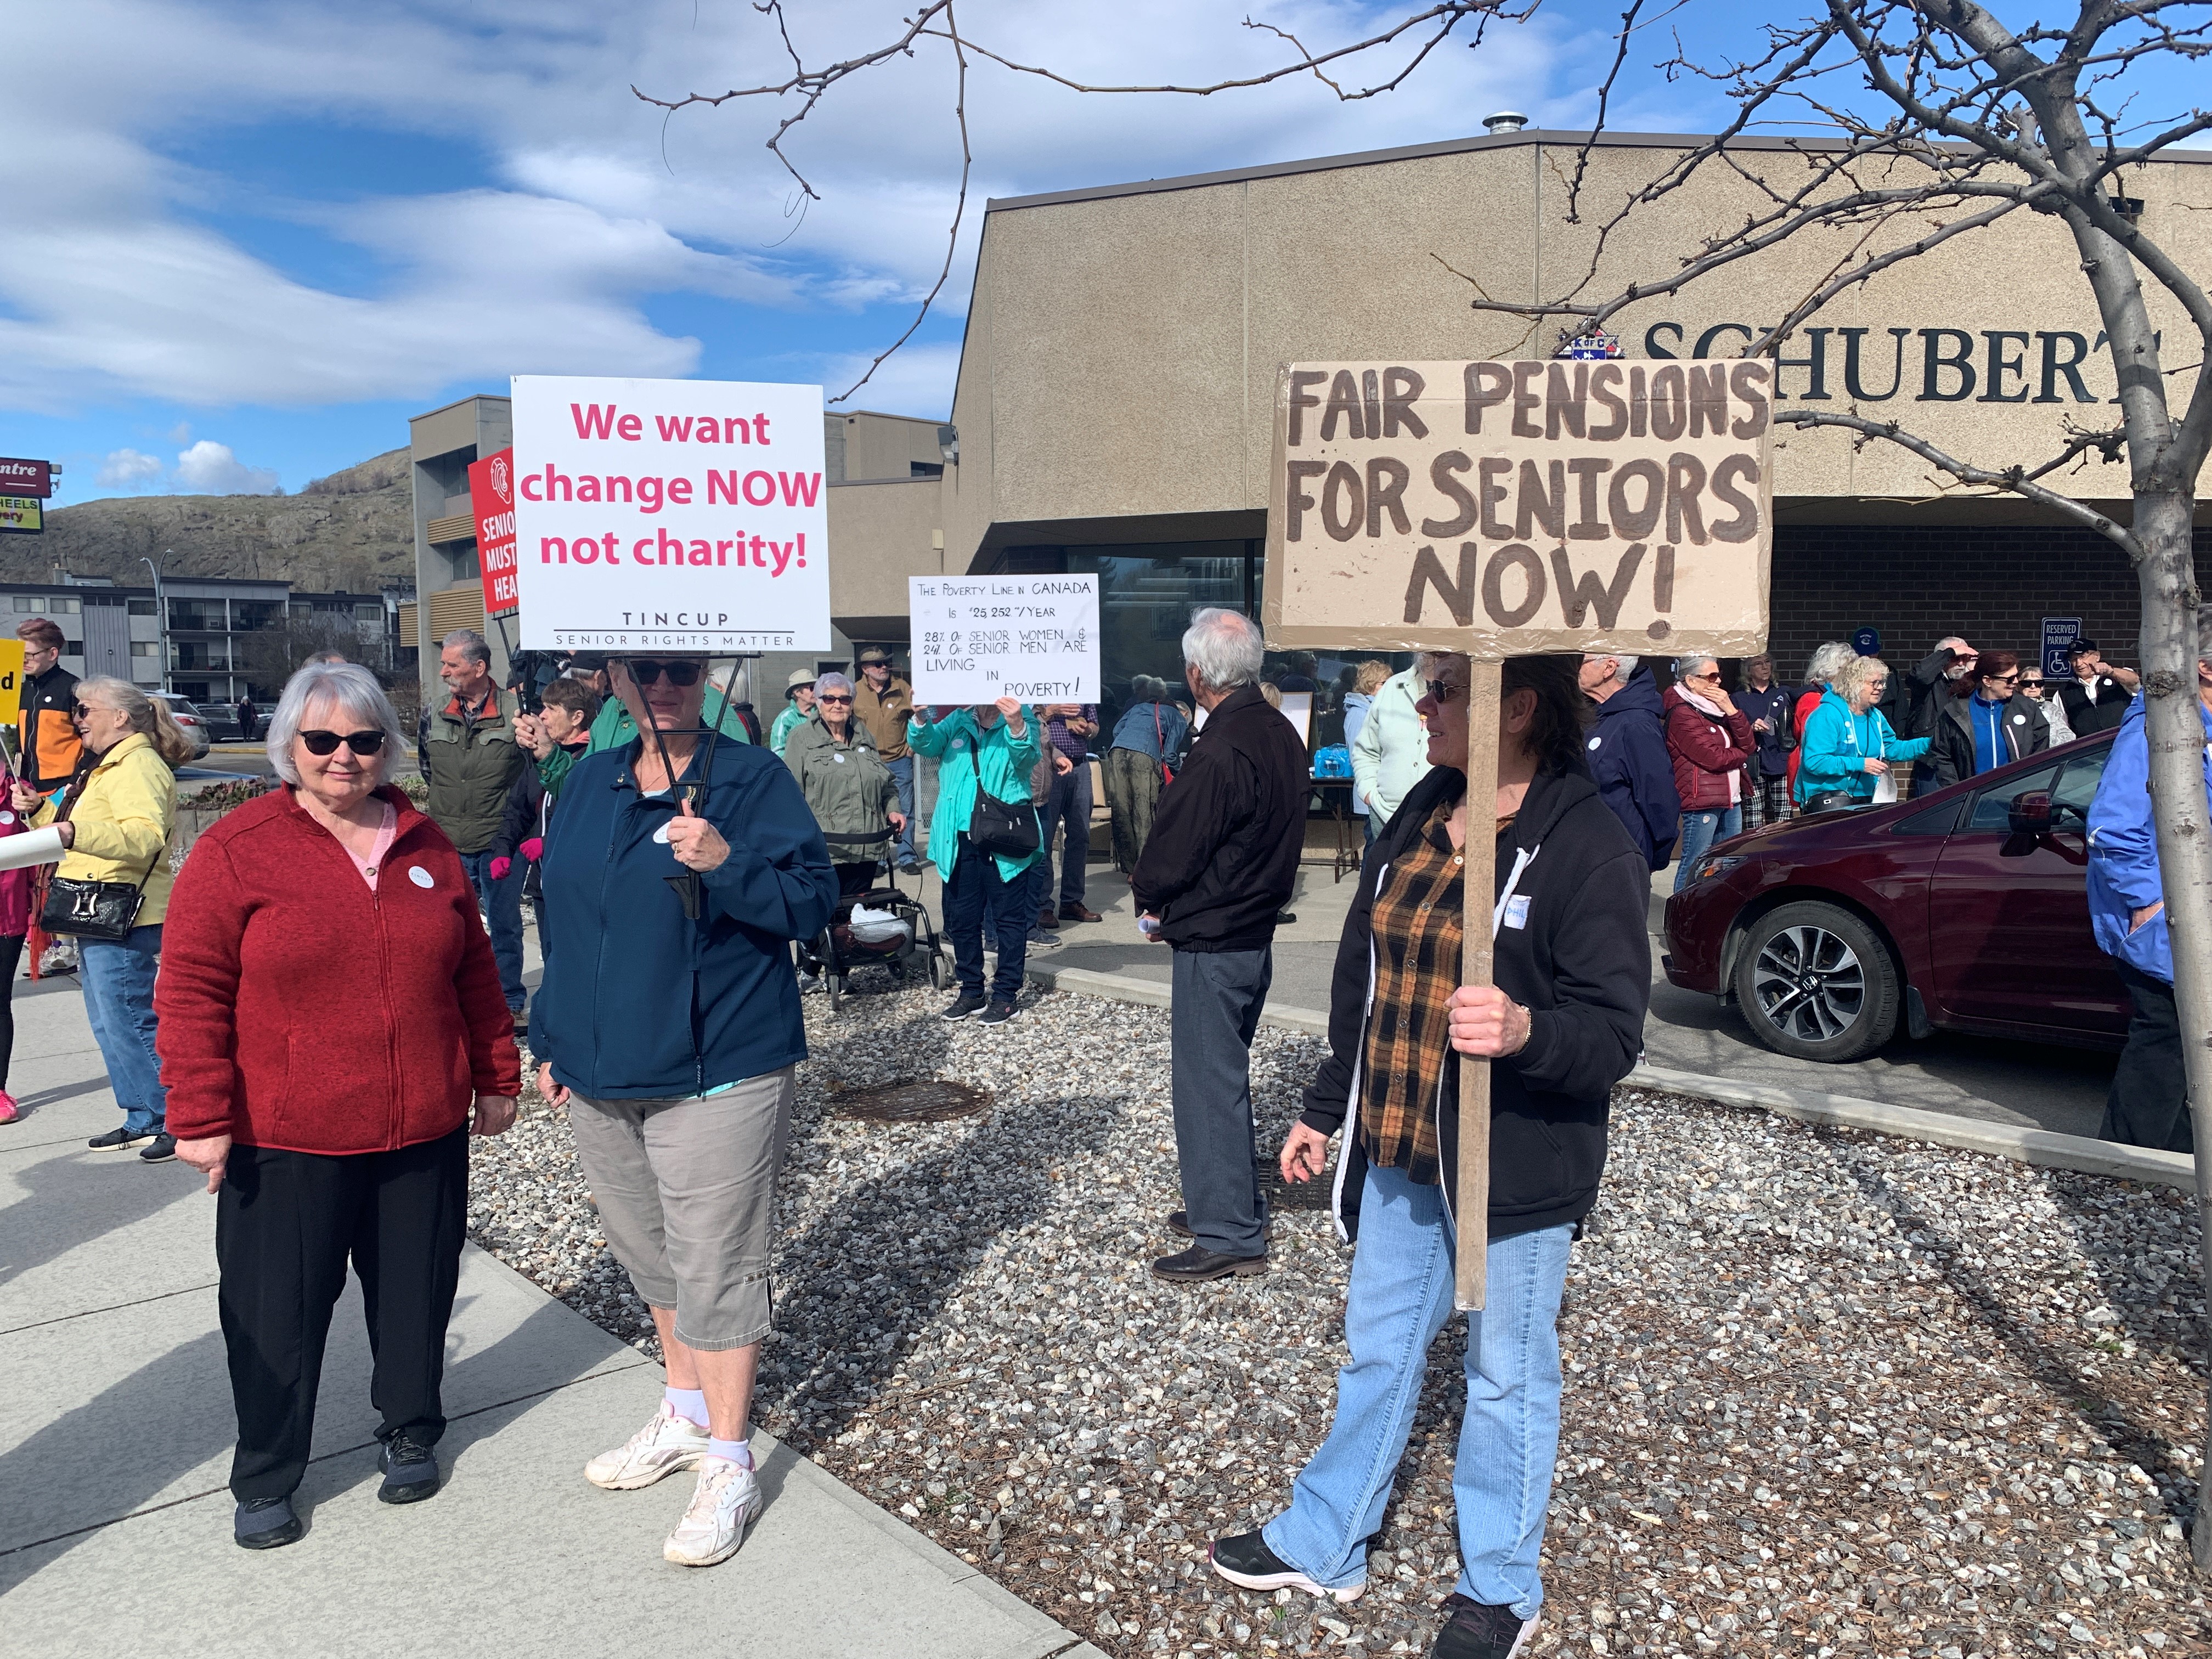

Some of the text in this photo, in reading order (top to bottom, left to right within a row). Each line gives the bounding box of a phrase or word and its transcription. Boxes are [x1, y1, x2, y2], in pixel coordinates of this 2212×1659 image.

[1574, 338, 1582, 347] K
[1597, 338, 1605, 348] C
[1287, 360, 1769, 446] FAIR PENSIONS
[571, 404, 770, 445] We want
[521, 464, 821, 514] change NOW
[1286, 449, 1760, 545] FOR SENIORS
[483, 511, 516, 542] SENIO
[486, 542, 516, 573] MUST
[541, 528, 806, 577] not charity!
[494, 573, 518, 602] HEA
[1032, 582, 1091, 595] CANADA
[1403, 541, 1677, 640] NOW!
[623, 612, 728, 626] TINCUP
[2046, 624, 2076, 634] RESERVED
[556, 635, 794, 646] SENIOR RIGHTS MATTER
[924, 632, 945, 642] 28%
[969, 630, 1010, 641] SENIOR
[1019, 629, 1064, 640] WOMEN
[923, 644, 940, 655] 24%
[969, 642, 1011, 654] SENIOR
[1020, 641, 1047, 653] MEN
[1062, 640, 1088, 652] ARE
[926, 658, 975, 672] LIVING
[987, 670, 998, 681] IN
[1005, 676, 1080, 697] POVERTY!
